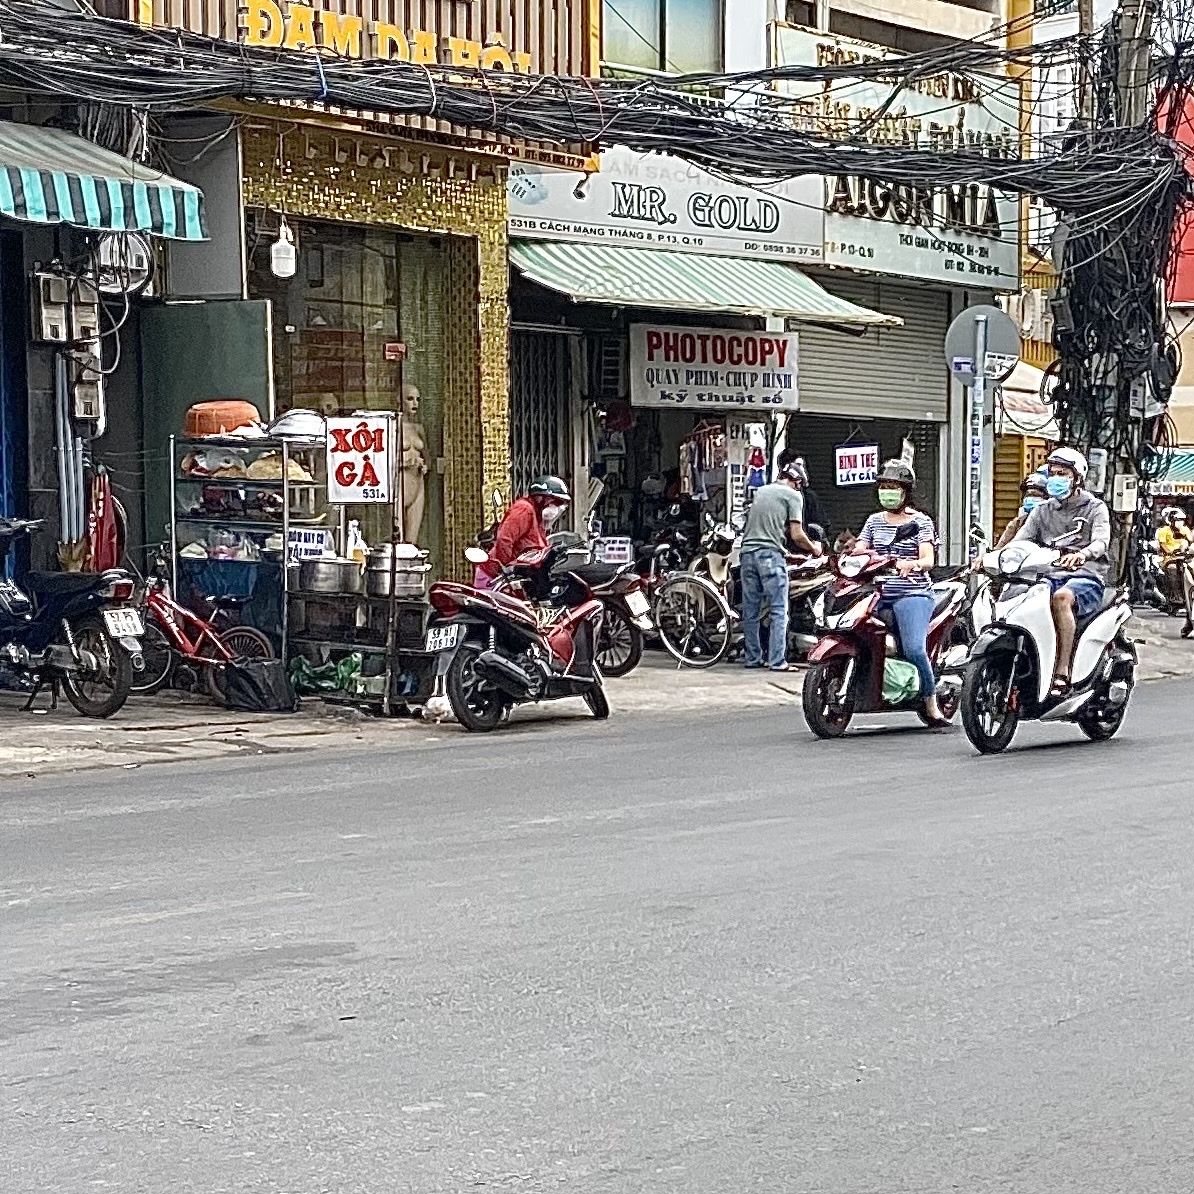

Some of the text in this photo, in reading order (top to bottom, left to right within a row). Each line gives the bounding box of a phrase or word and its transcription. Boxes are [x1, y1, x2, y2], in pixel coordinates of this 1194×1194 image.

[608, 181, 678, 226] MR.
[687, 192, 780, 234] GOLD
[510, 219, 536, 229] 531B
[646, 330, 789, 368] PHOTOCOPY
[645, 367, 679, 388] QUAY
[762, 368, 792, 389] HÌNH
[696, 392, 756, 405] thuật
[329, 421, 385, 453] XÔI
